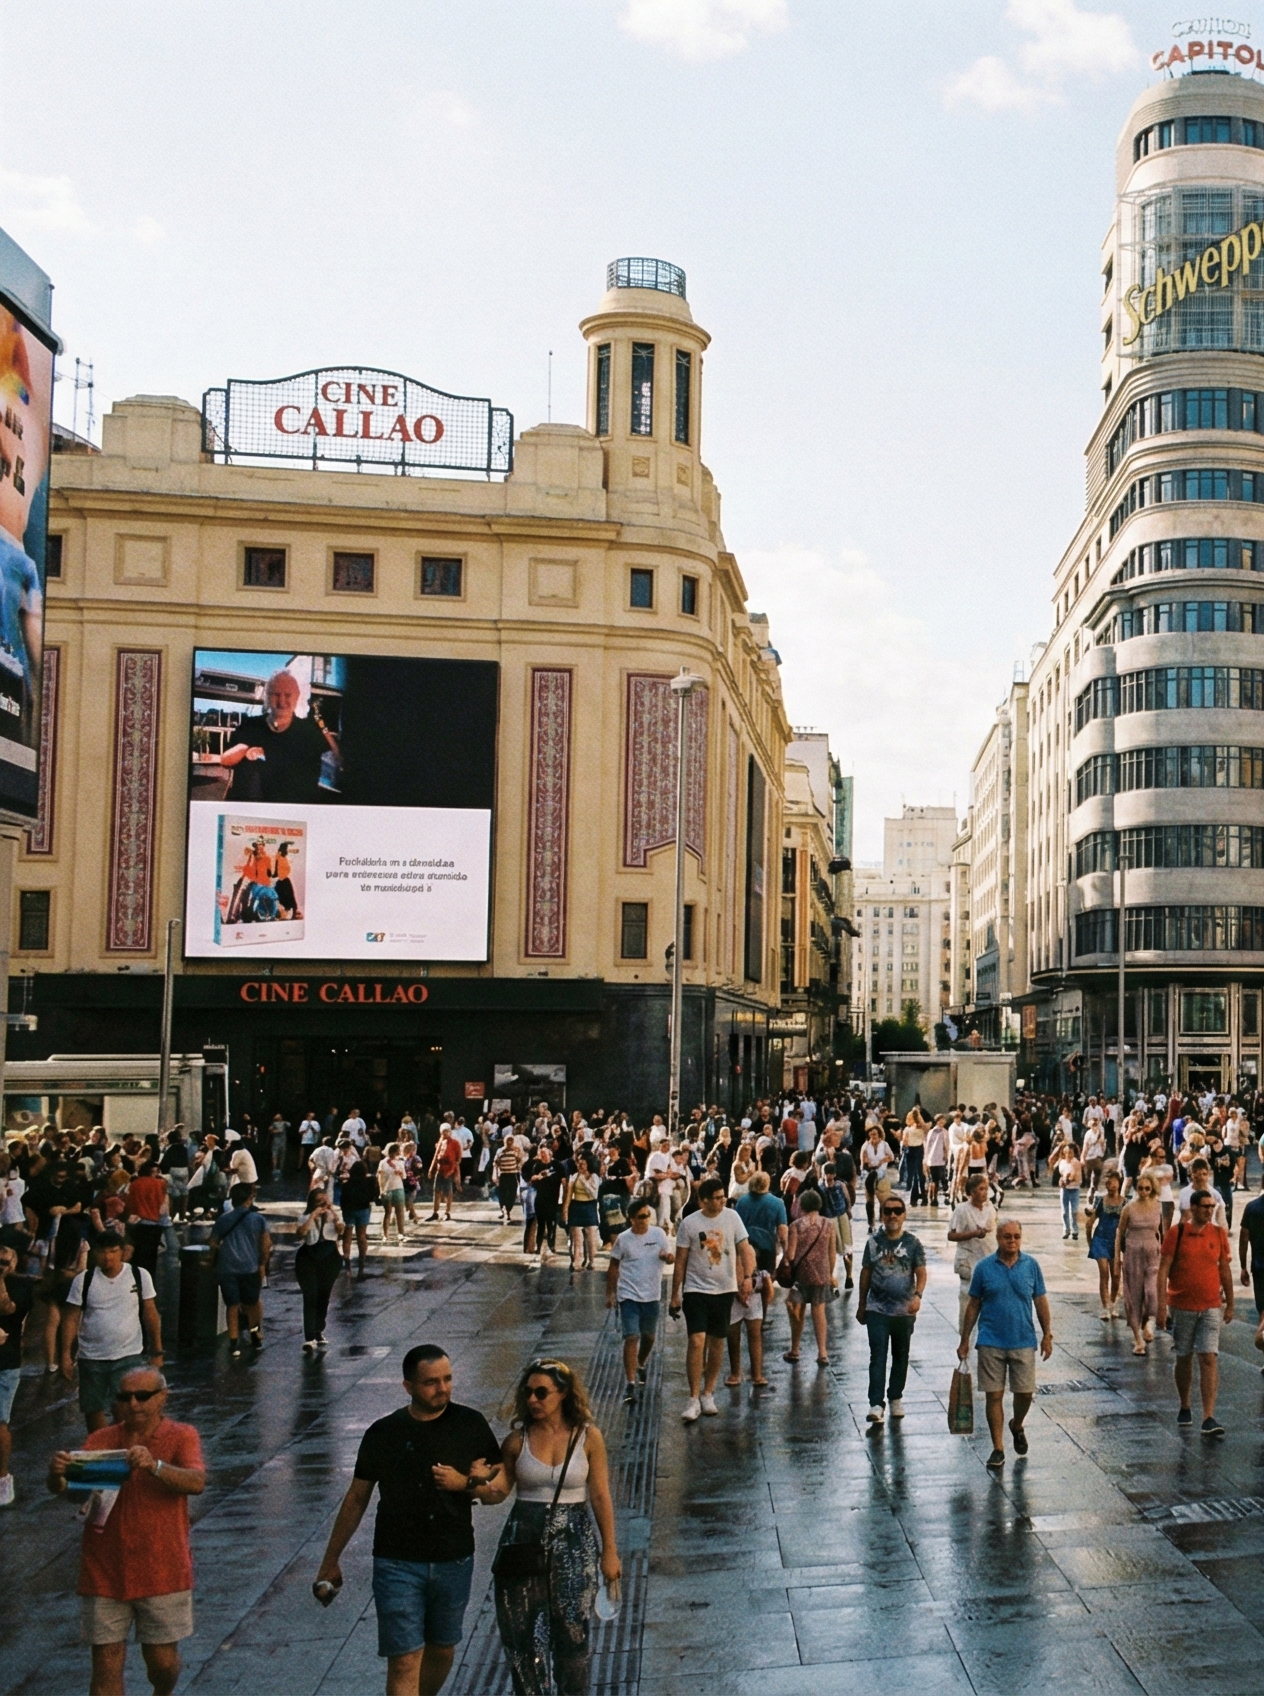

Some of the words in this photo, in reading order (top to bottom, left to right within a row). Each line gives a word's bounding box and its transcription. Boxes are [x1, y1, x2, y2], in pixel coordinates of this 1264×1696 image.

[321, 381, 399, 407] CINE
[274, 405, 444, 444] CALLAO
[240, 982, 309, 1003] CINE
[319, 983, 429, 1003] CALLAO
